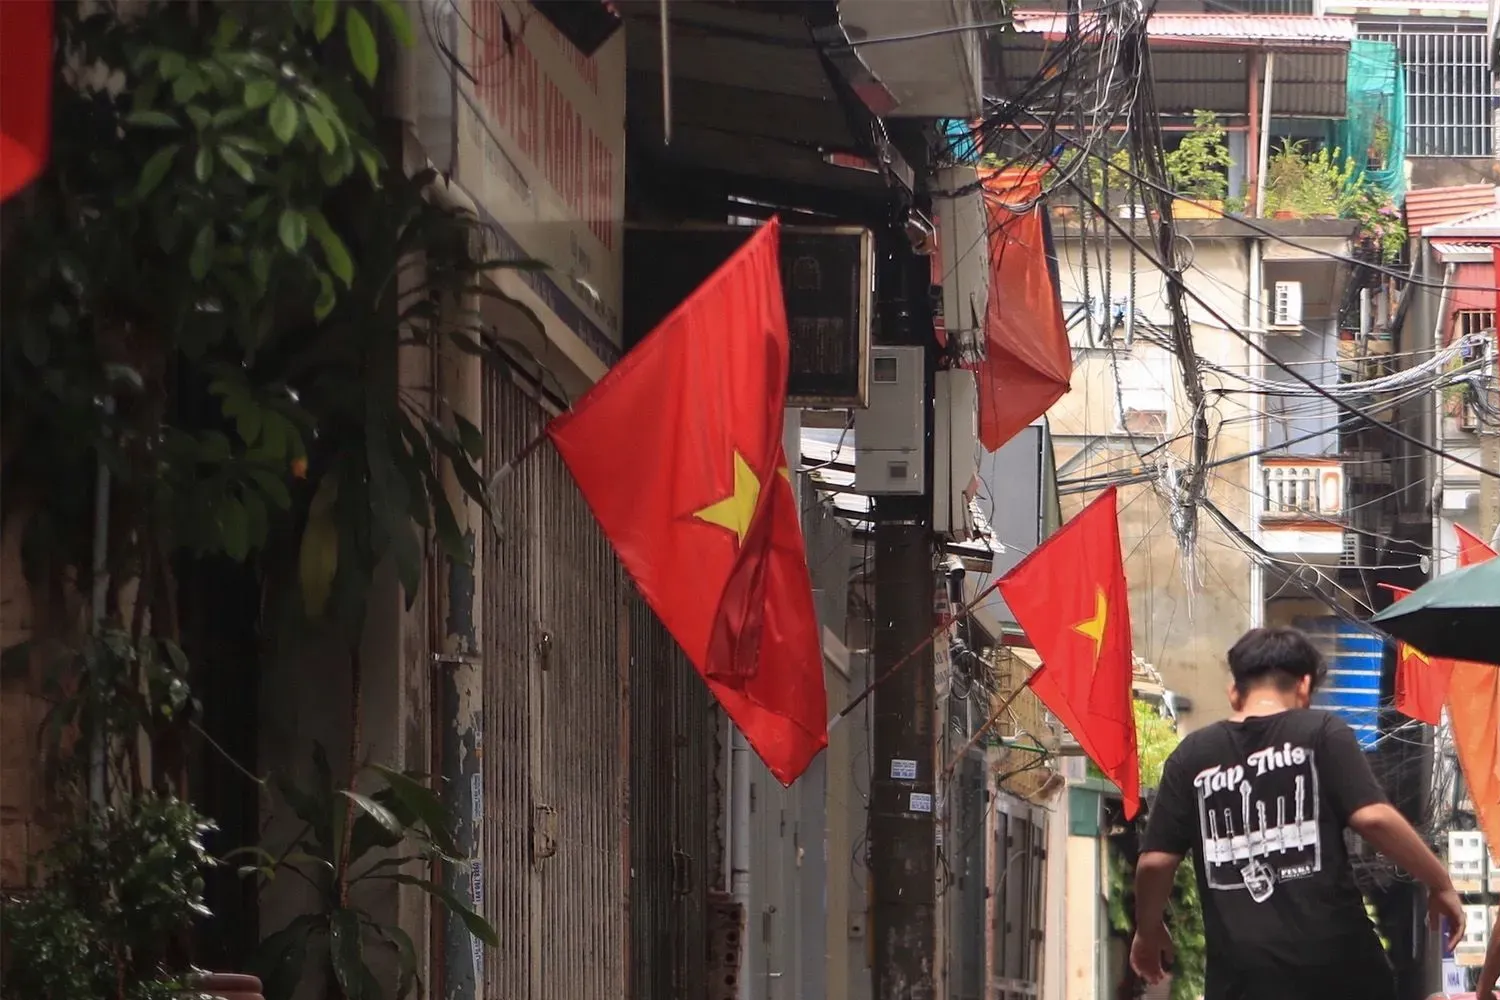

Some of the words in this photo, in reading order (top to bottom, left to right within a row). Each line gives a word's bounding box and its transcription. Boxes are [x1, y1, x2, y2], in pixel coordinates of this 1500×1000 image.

[544, 72, 583, 222] KHOA
[588, 128, 613, 253] NHI
[1193, 764, 1244, 798] Tap
[1247, 742, 1306, 776] This
